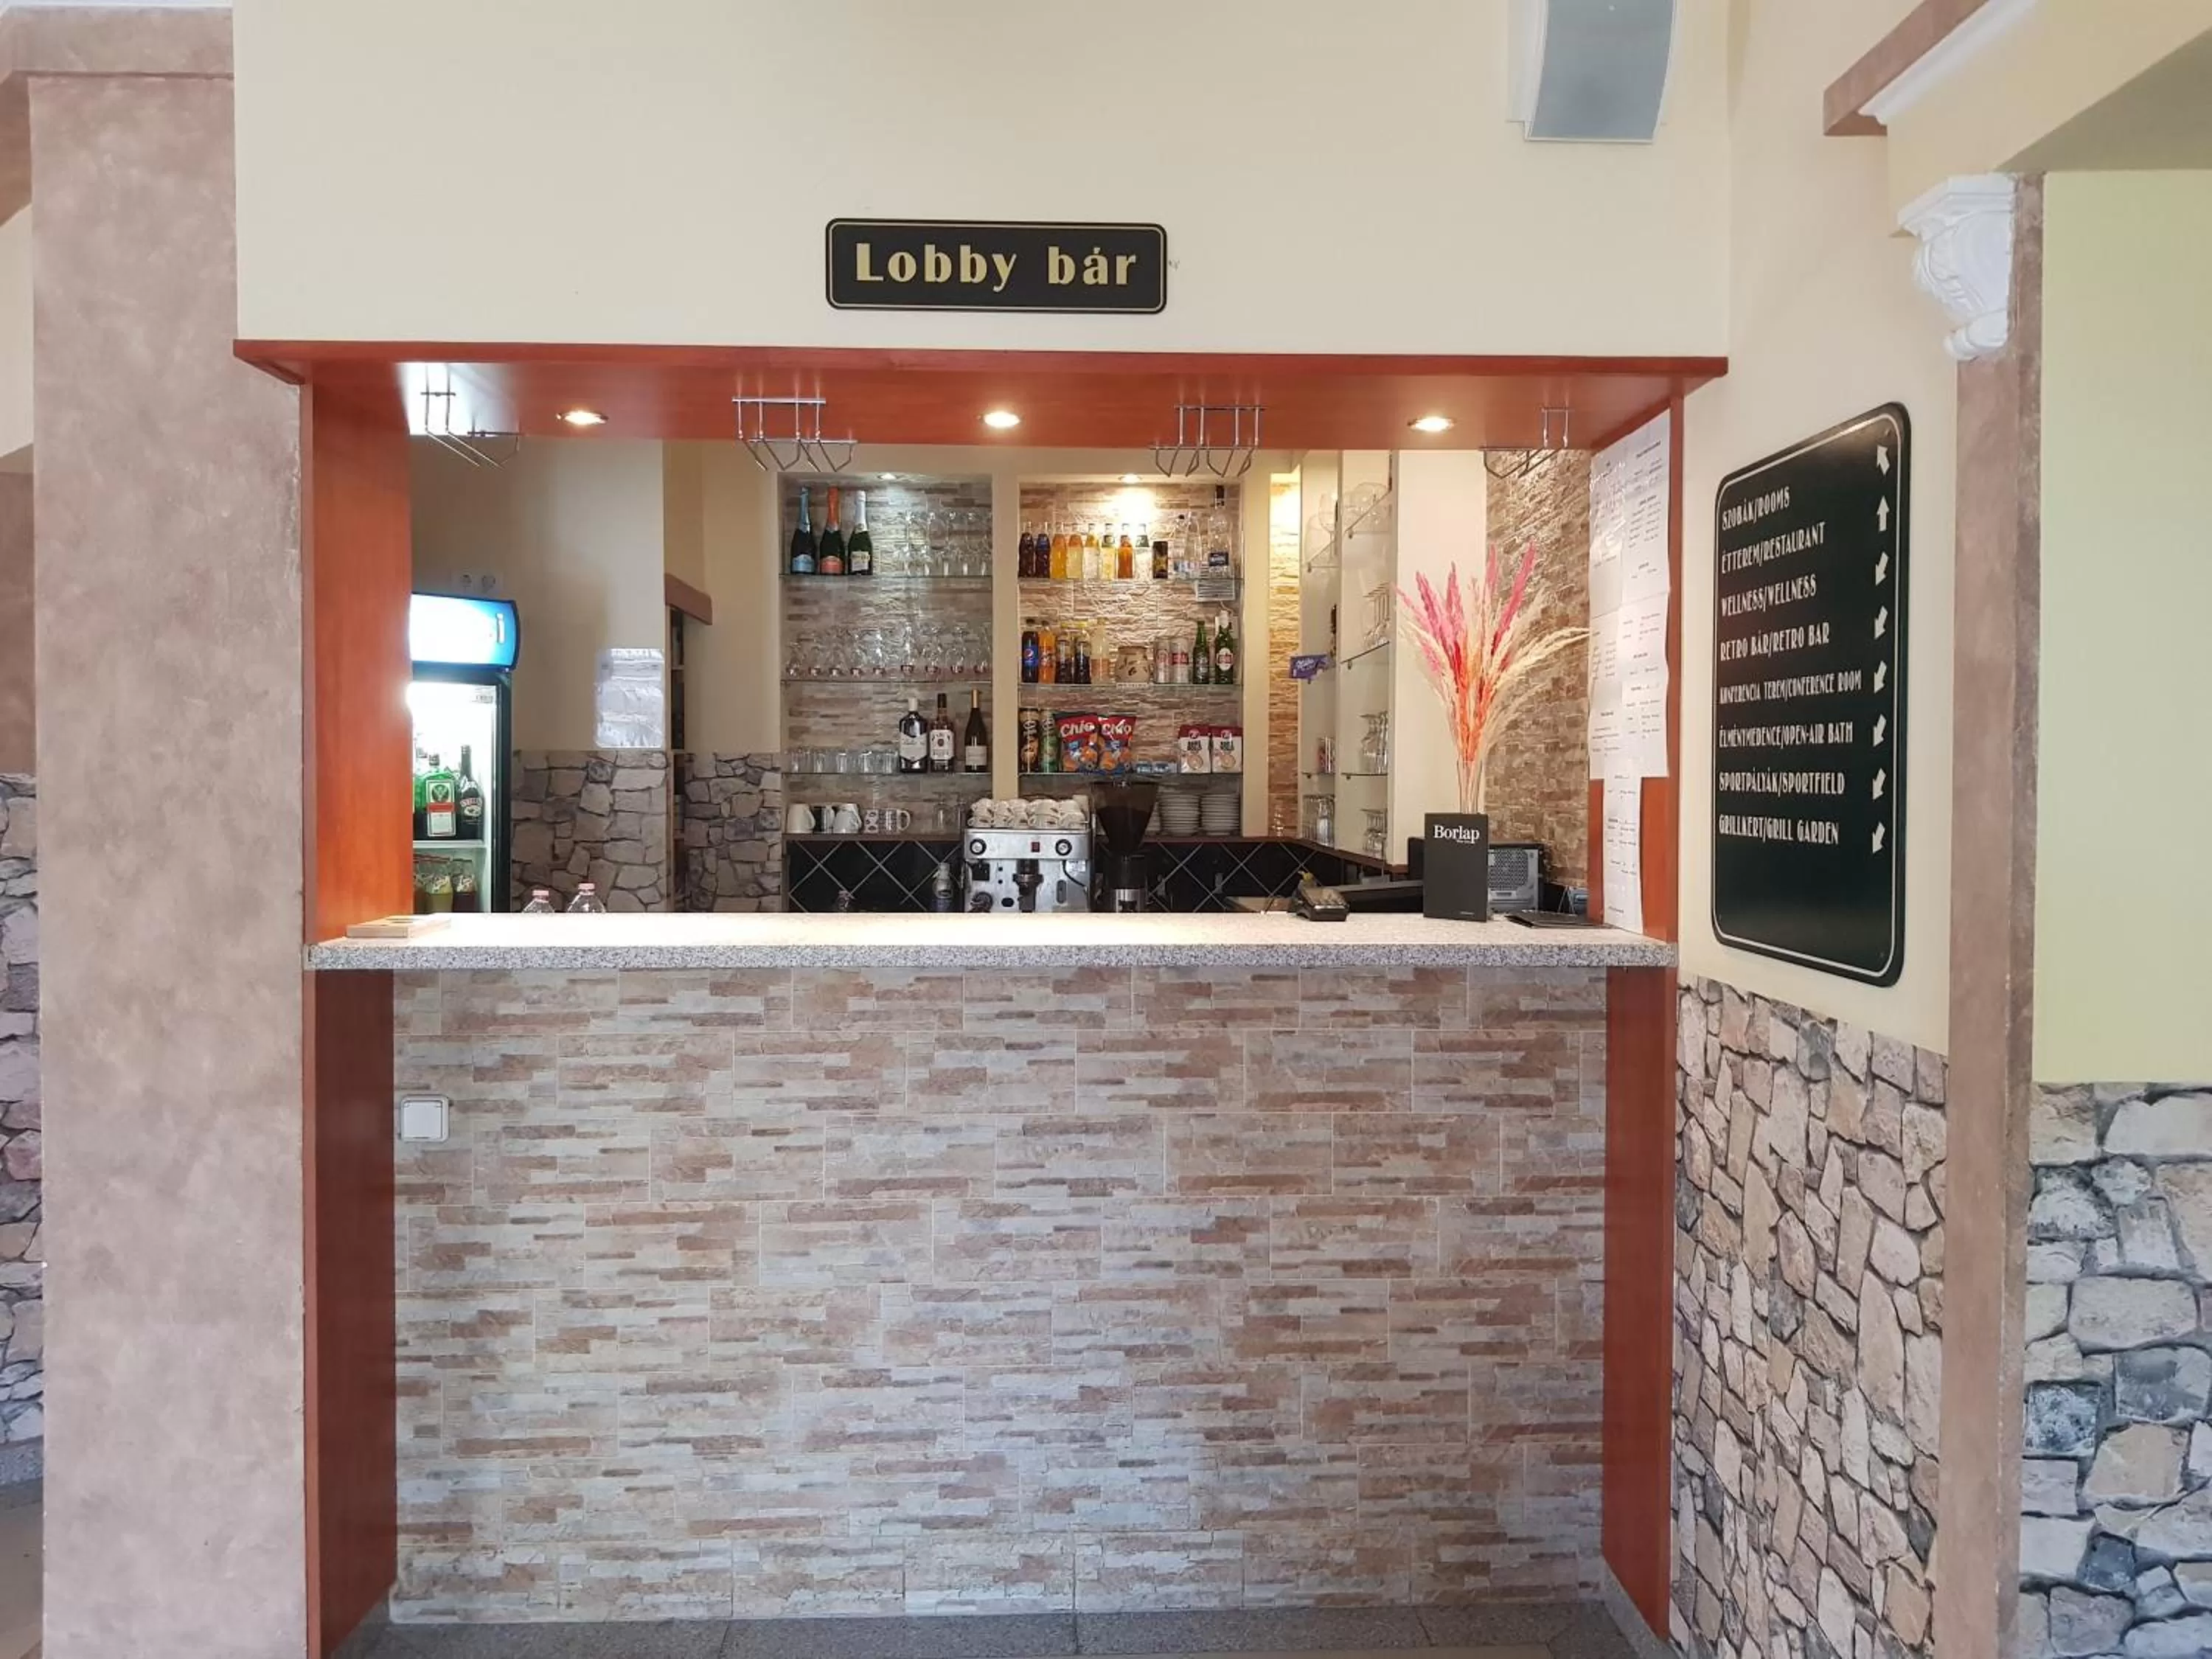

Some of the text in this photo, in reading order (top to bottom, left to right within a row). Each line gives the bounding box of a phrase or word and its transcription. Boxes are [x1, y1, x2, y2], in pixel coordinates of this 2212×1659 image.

[855, 243, 1136, 292] Lobby bár
[1722, 486, 1790, 531] SZOBÁK/ROOMS
[1722, 521, 1826, 574] ÉTTEREM/RESTAURANT
[1721, 574, 1817, 617] WELLNESS/WELLNESS
[1720, 622, 1830, 661] RETRO BÁR/RETRO BAR
[1837, 669, 1862, 692] ROOM
[1060, 720, 1095, 737] Chio
[1828, 722, 1853, 744] BATH
[1719, 767, 1846, 797] SPORTPÁLYÁK/SPORTFIELD
[1433, 824, 1480, 844] Borlap
[1719, 814, 1840, 844] GRILLKERT/GRILL GARDEN
